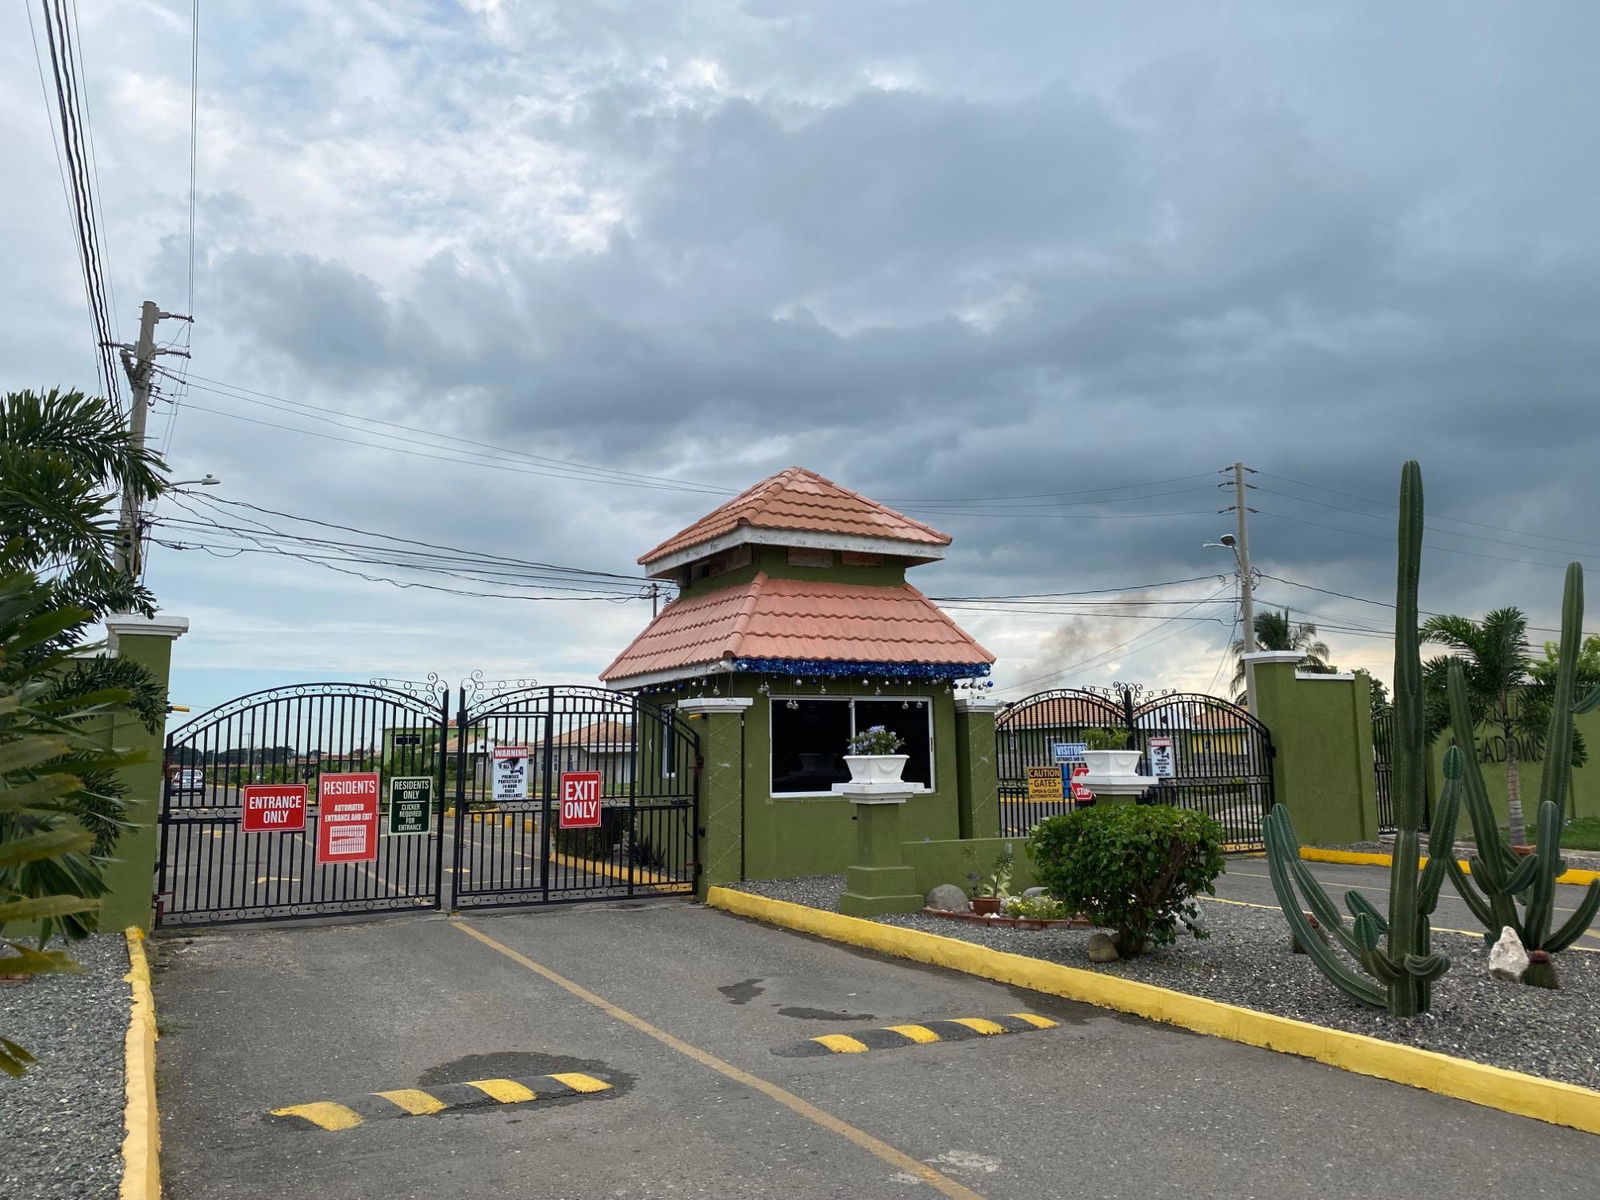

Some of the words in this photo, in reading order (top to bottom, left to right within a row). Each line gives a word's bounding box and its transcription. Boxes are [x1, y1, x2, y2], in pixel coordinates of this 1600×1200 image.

[495, 748, 528, 757] WARNING
[1448, 735, 1546, 764] EADOWS
[1030, 769, 1060, 778] CAUTION
[324, 780, 376, 795] RESIDENTS
[394, 780, 430, 790] RESIDENTS
[1034, 779, 1057, 788] GATES
[404, 790, 420, 800] ONLY
[565, 780, 598, 800] EXIT
[249, 795, 302, 810] ENTRANCE
[565, 800, 597, 819] ONLY
[263, 810, 289, 824] ONLY
[398, 824, 422, 832] ENTRANCE
